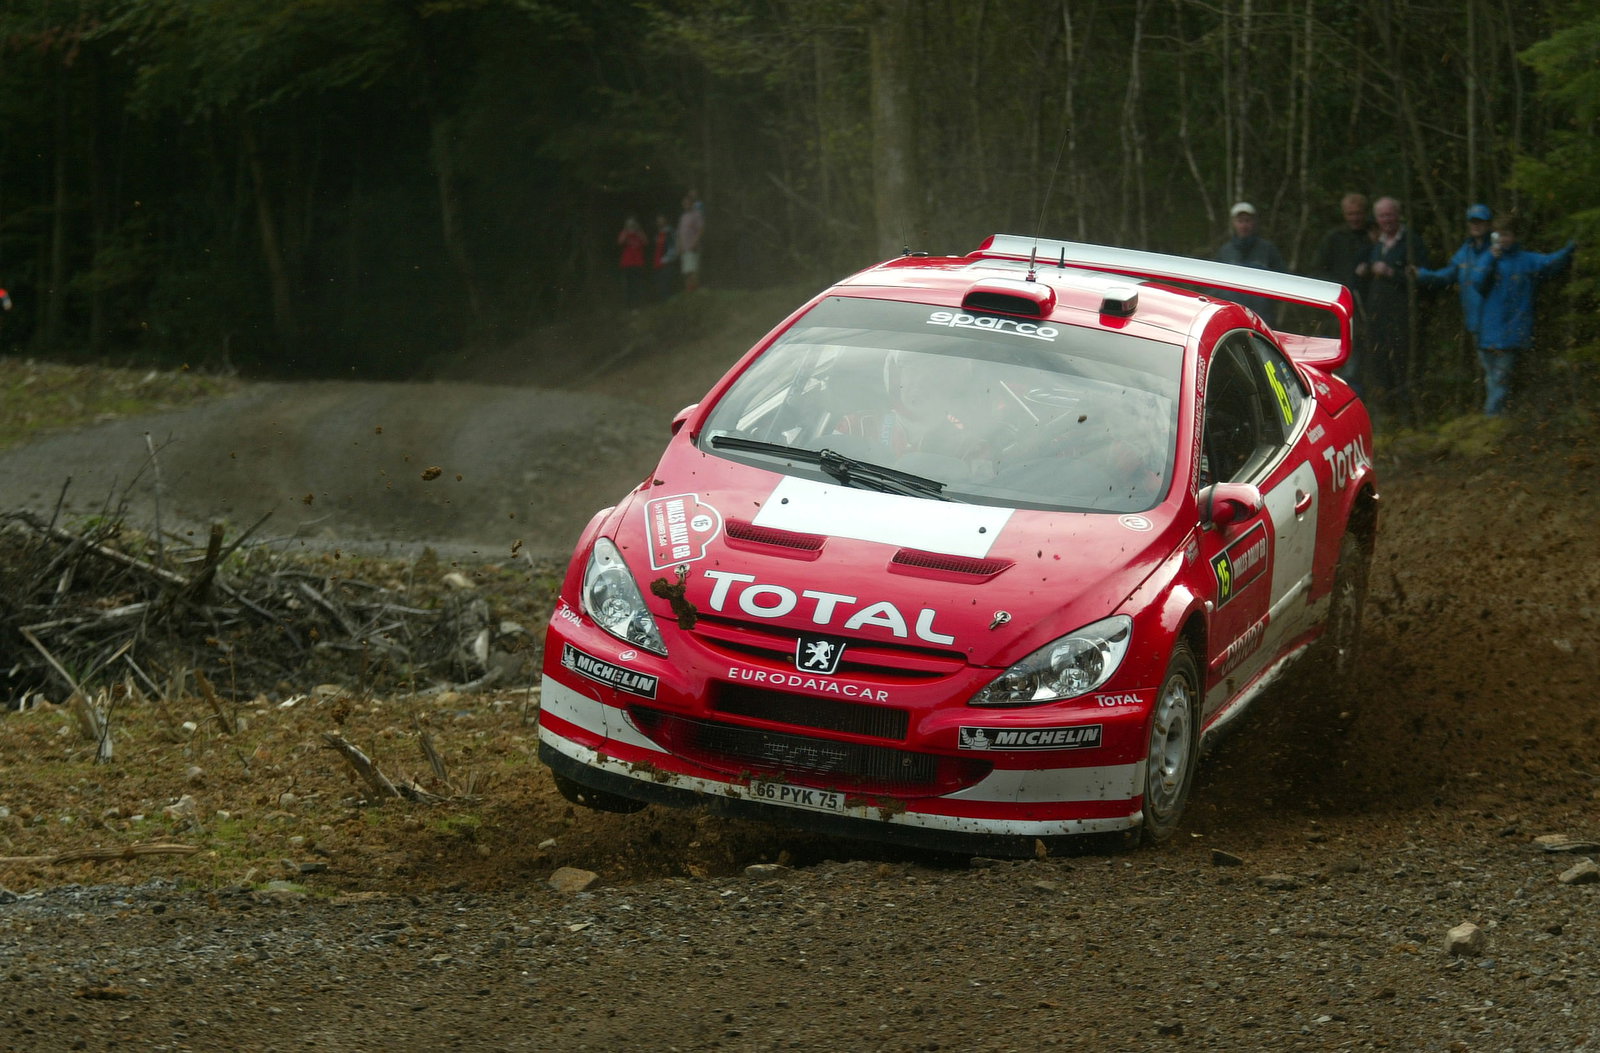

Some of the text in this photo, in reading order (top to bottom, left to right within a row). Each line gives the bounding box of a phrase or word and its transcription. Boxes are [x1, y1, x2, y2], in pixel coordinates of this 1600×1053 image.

[928, 311, 1059, 339] sparco
[1264, 360, 1293, 426] 15
[1322, 434, 1373, 492] TOTAL
[666, 499, 691, 559] WALES RALLY GB
[693, 518, 709, 527] 15
[1217, 560, 1230, 598] 15
[559, 604, 583, 628] TOTAL
[703, 569, 955, 645] TOTAL
[577, 655, 654, 692] MICHELIN
[728, 667, 889, 702] EURODATACAR
[1095, 693, 1143, 707] TOTAL
[995, 728, 1099, 745] MICHELIN
[756, 784, 838, 809] 66 PYK 75
